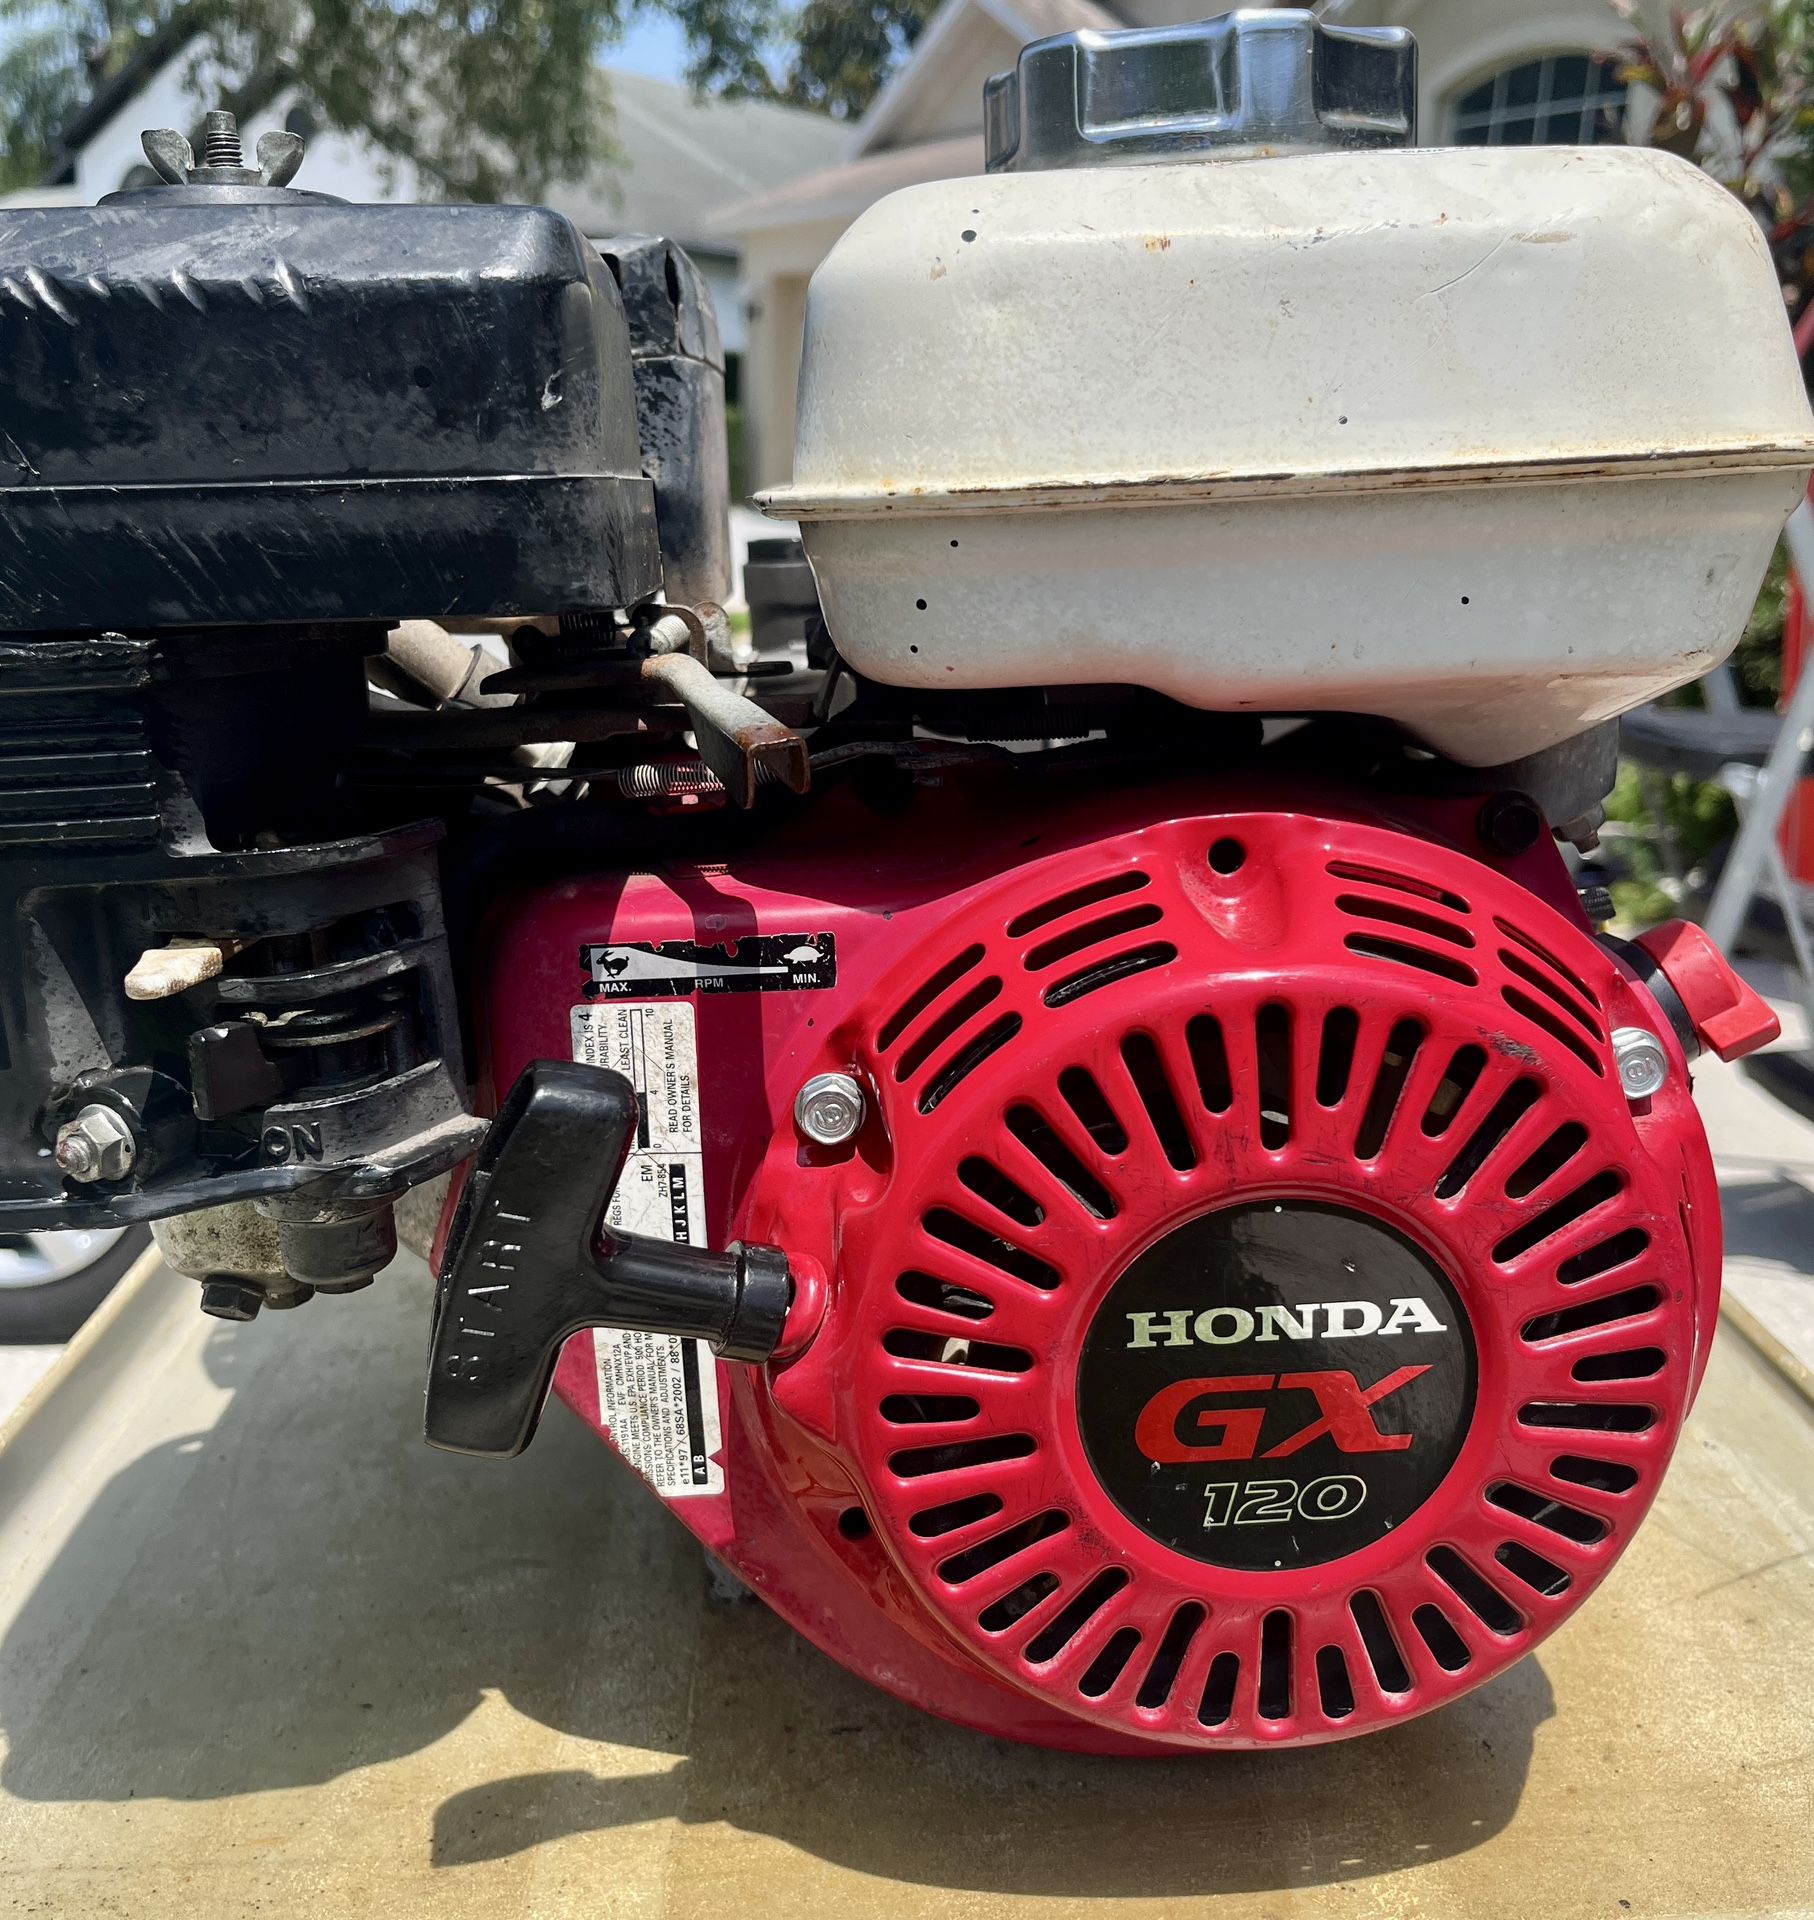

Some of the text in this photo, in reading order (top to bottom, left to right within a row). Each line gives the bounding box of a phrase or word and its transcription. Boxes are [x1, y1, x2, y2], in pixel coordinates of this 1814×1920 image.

[599, 983, 632, 993] MAX.
[694, 978, 724, 989] RPM
[792, 973, 821, 984] MIN.
[645, 1009, 654, 1017] 10
[585, 1036, 595, 1063] INDEX
[618, 1010, 630, 1070] LEAST CLEAN
[663, 1020, 678, 1132] READ OWNER'S MANUAL
[683, 1115, 692, 1132] FOR
[262, 1121, 324, 1162] ON
[641, 1165, 653, 1181] EM
[613, 1206, 622, 1225] REGS
[446, 1199, 531, 1384] START
[1126, 1297, 1447, 1348] HONDA
[622, 1333, 631, 1349] AND
[635, 1346, 643, 1359] 500
[646, 1343, 654, 1357] FOR
[624, 1351, 634, 1382] EXH/EVP
[647, 1360, 657, 1393] MANUAL
[603, 1359, 615, 1410] INFORMATION
[627, 1385, 636, 1397] EPA
[639, 1394, 650, 1441] COMPLIANCE
[650, 1397, 660, 1430] OWNER'S
[662, 1408, 670, 1423] AND
[1135, 1364, 1434, 1464] GX
[630, 1416, 639, 1439] MEETS
[653, 1433, 662, 1446] THE
[654, 1450, 663, 1460] TO
[663, 1426, 676, 1486] SPECIFICATIONS
[656, 1464, 664, 1487] REFER
[1203, 1475, 1367, 1528] 120
